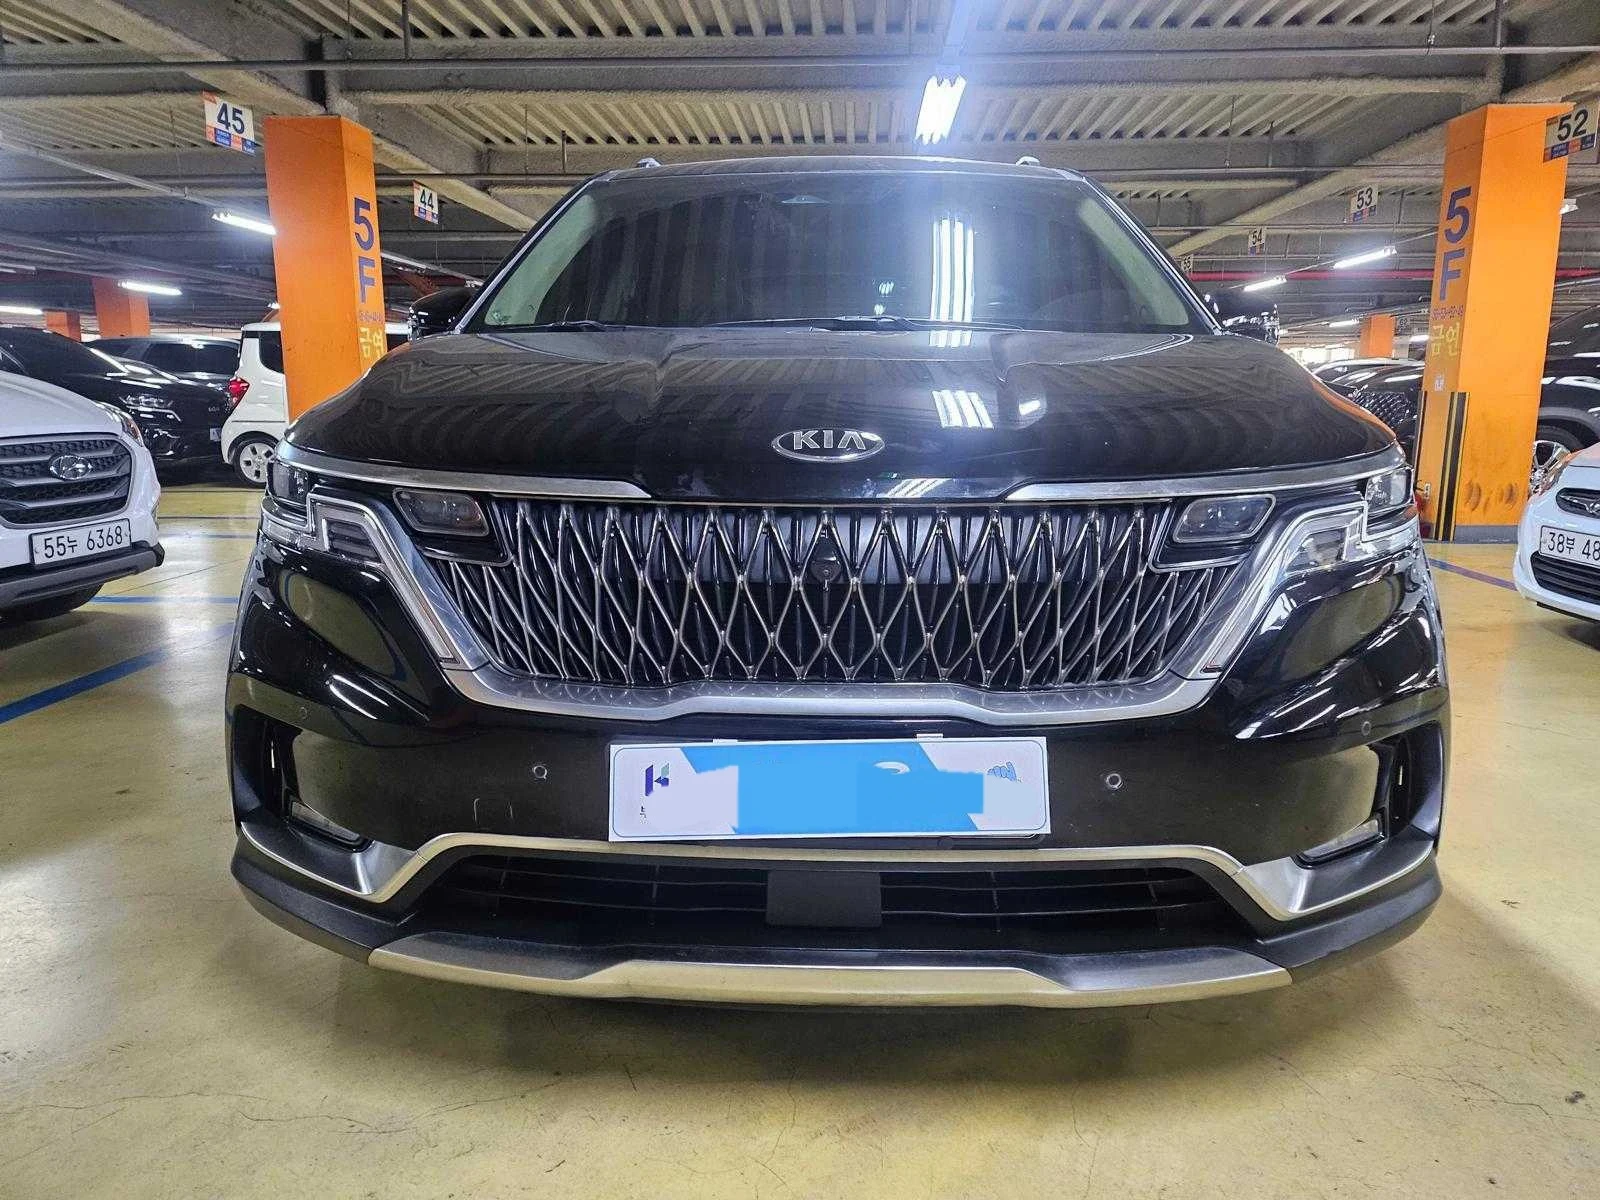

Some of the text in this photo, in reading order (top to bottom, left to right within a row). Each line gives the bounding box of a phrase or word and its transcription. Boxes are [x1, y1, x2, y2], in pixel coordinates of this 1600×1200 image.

[217, 102, 245, 134] 45
[1557, 109, 1588, 141] 52
[420, 189, 434, 209] 44
[1357, 187, 1372, 209] 53
[1252, 228, 1263, 245] 54
[1430, 322, 1460, 357] 금연
[793, 429, 866, 451] KIA
[44, 525, 122, 559] 55누 6368
[1547, 532, 1600, 561] 38부 48
